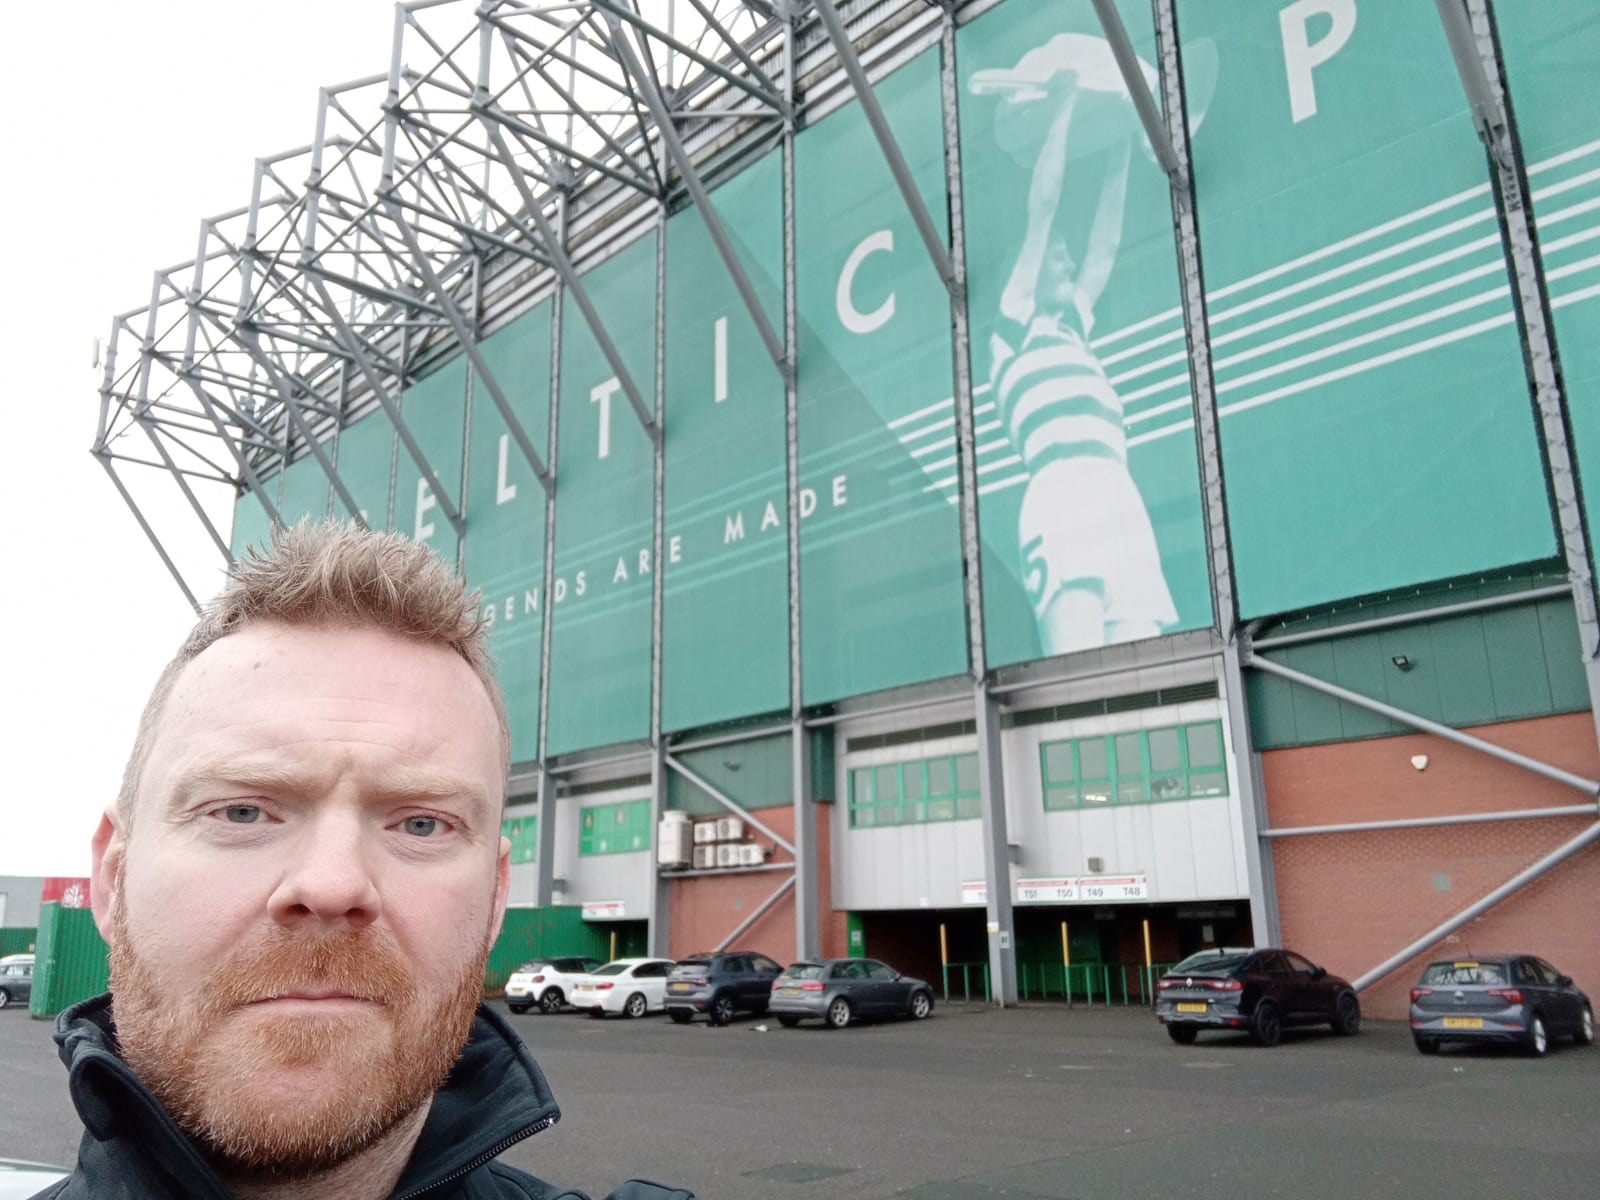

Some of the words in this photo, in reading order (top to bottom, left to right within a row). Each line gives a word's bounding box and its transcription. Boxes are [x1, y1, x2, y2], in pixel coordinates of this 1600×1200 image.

[352, 229, 896, 541] ELTIC
[612, 535, 682, 584] ARE
[724, 474, 848, 544] MADE
[1124, 886, 1141, 896] T48
